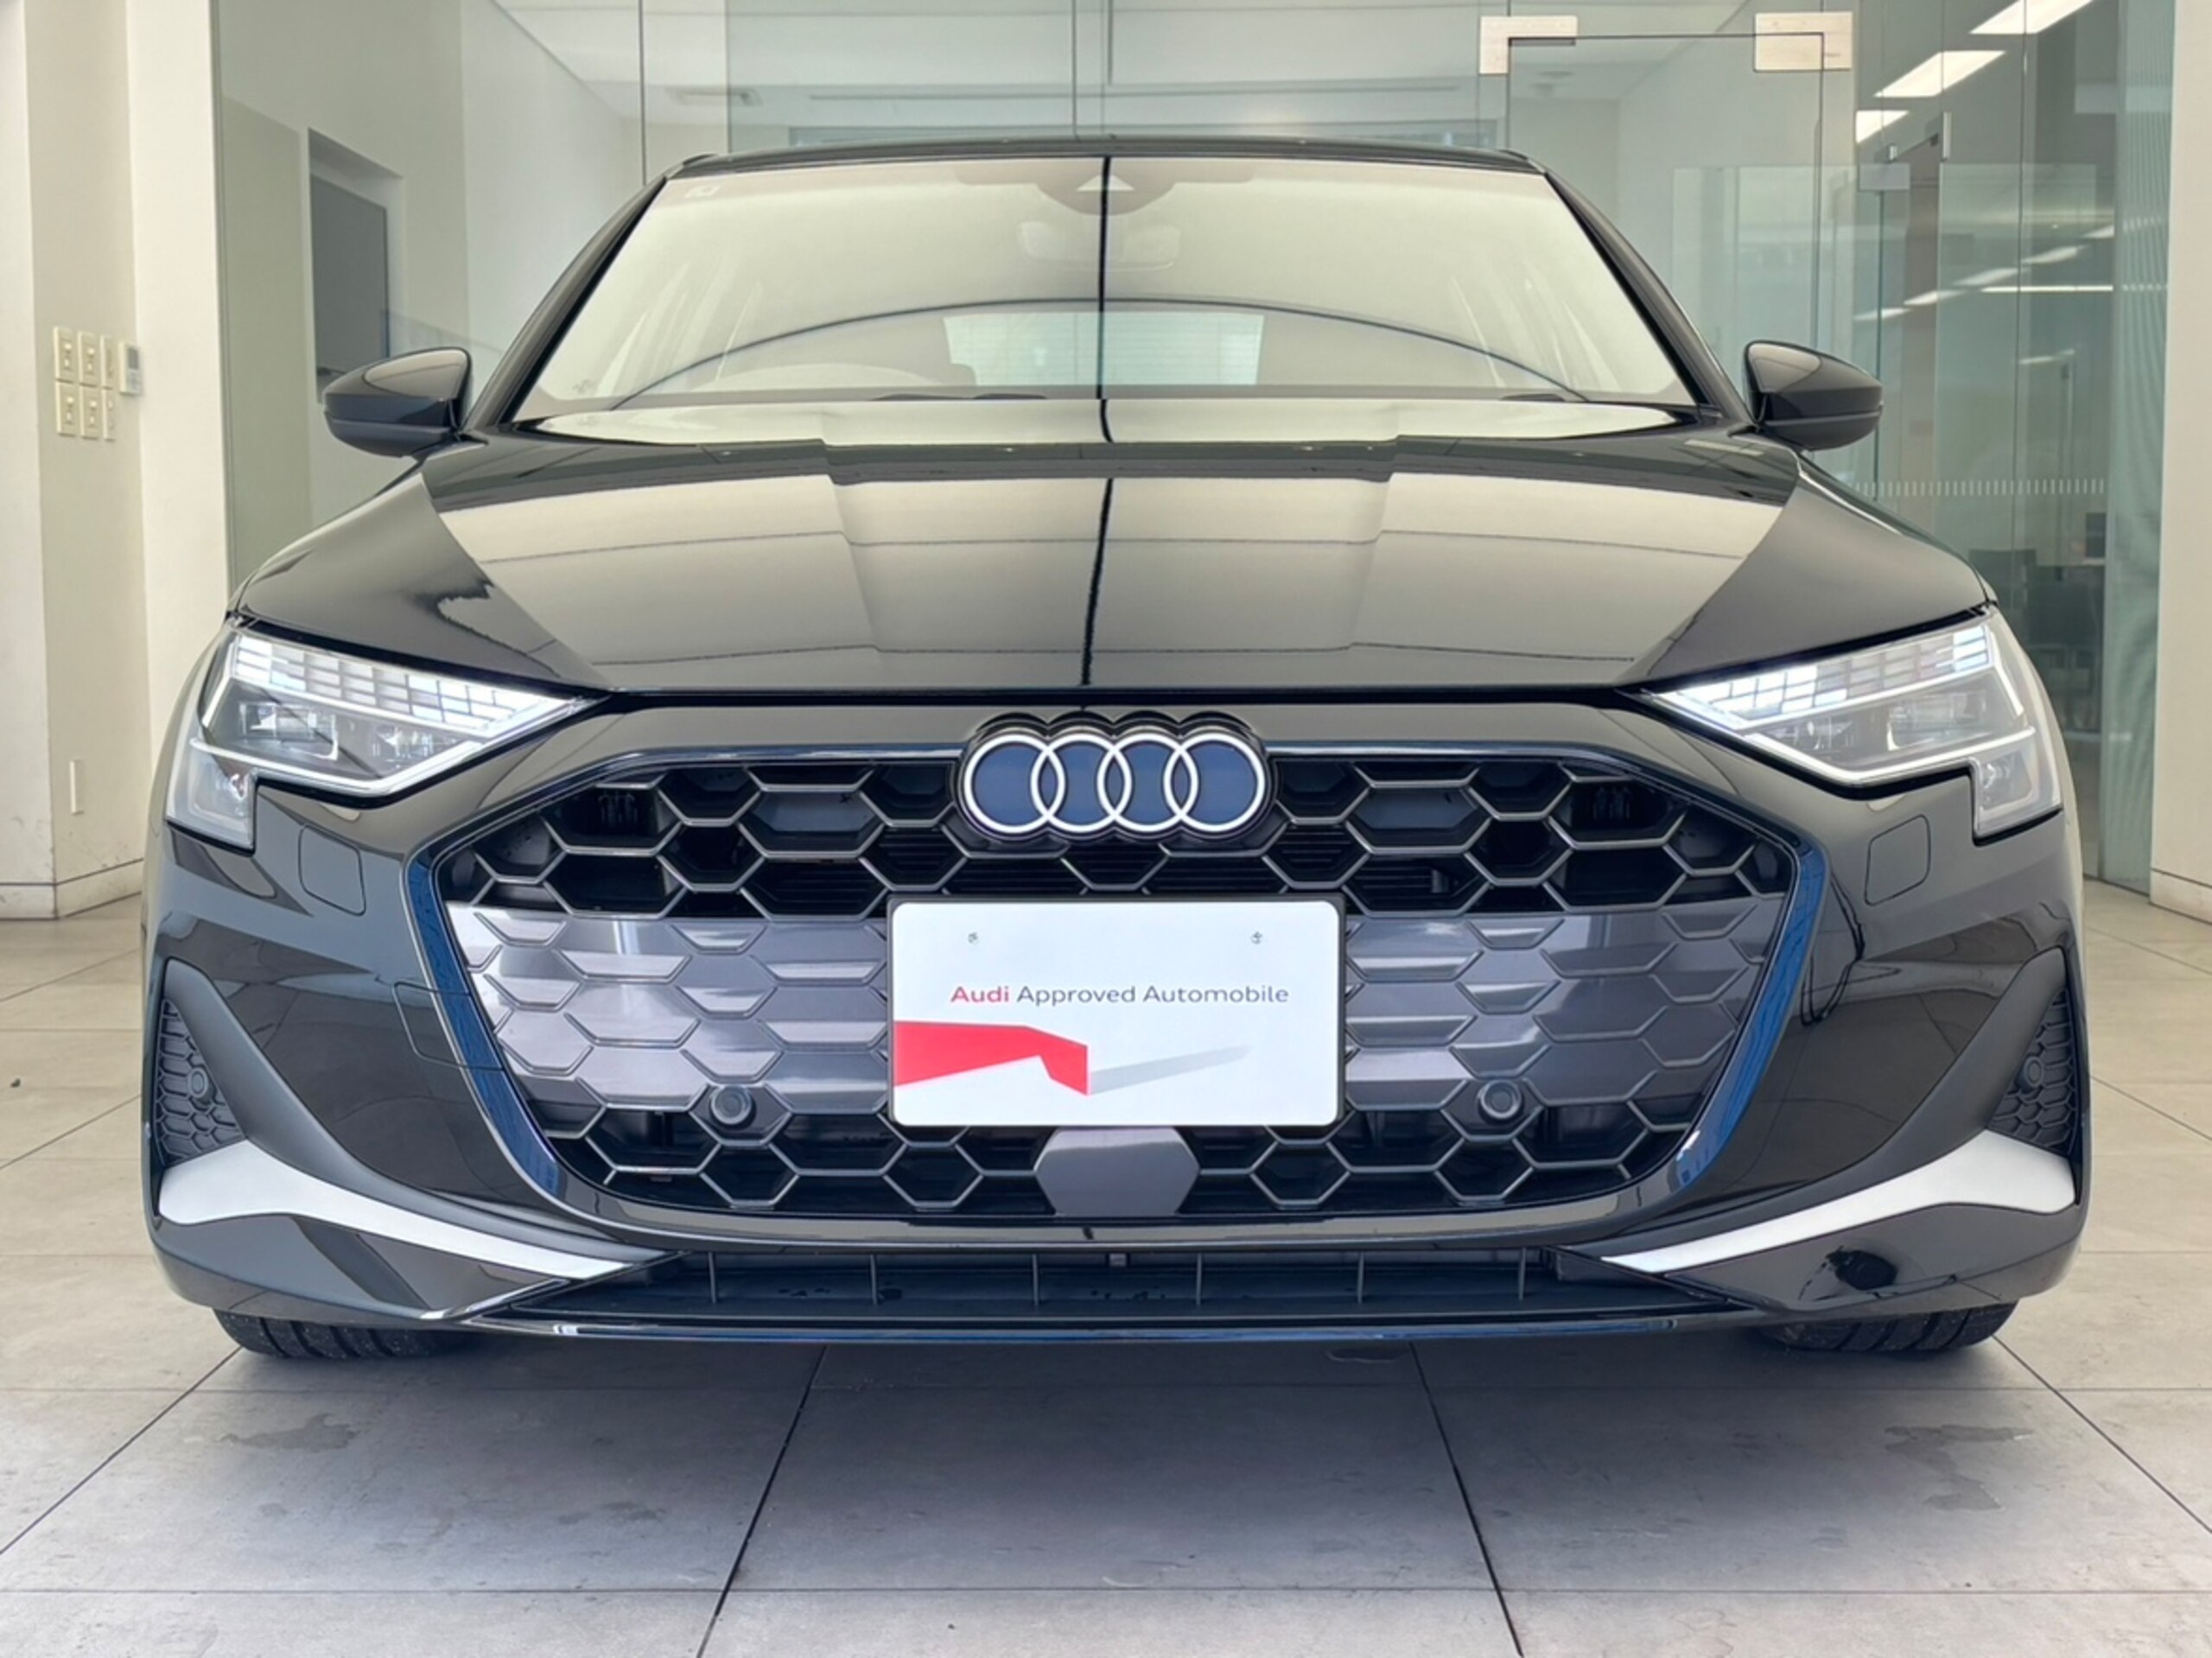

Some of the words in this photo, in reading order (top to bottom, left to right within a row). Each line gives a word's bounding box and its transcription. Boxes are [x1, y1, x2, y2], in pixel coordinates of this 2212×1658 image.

[950, 985, 1010, 1003] Audi
[1016, 985, 1136, 1007] Approved
[1142, 985, 1289, 1003] Automobile
